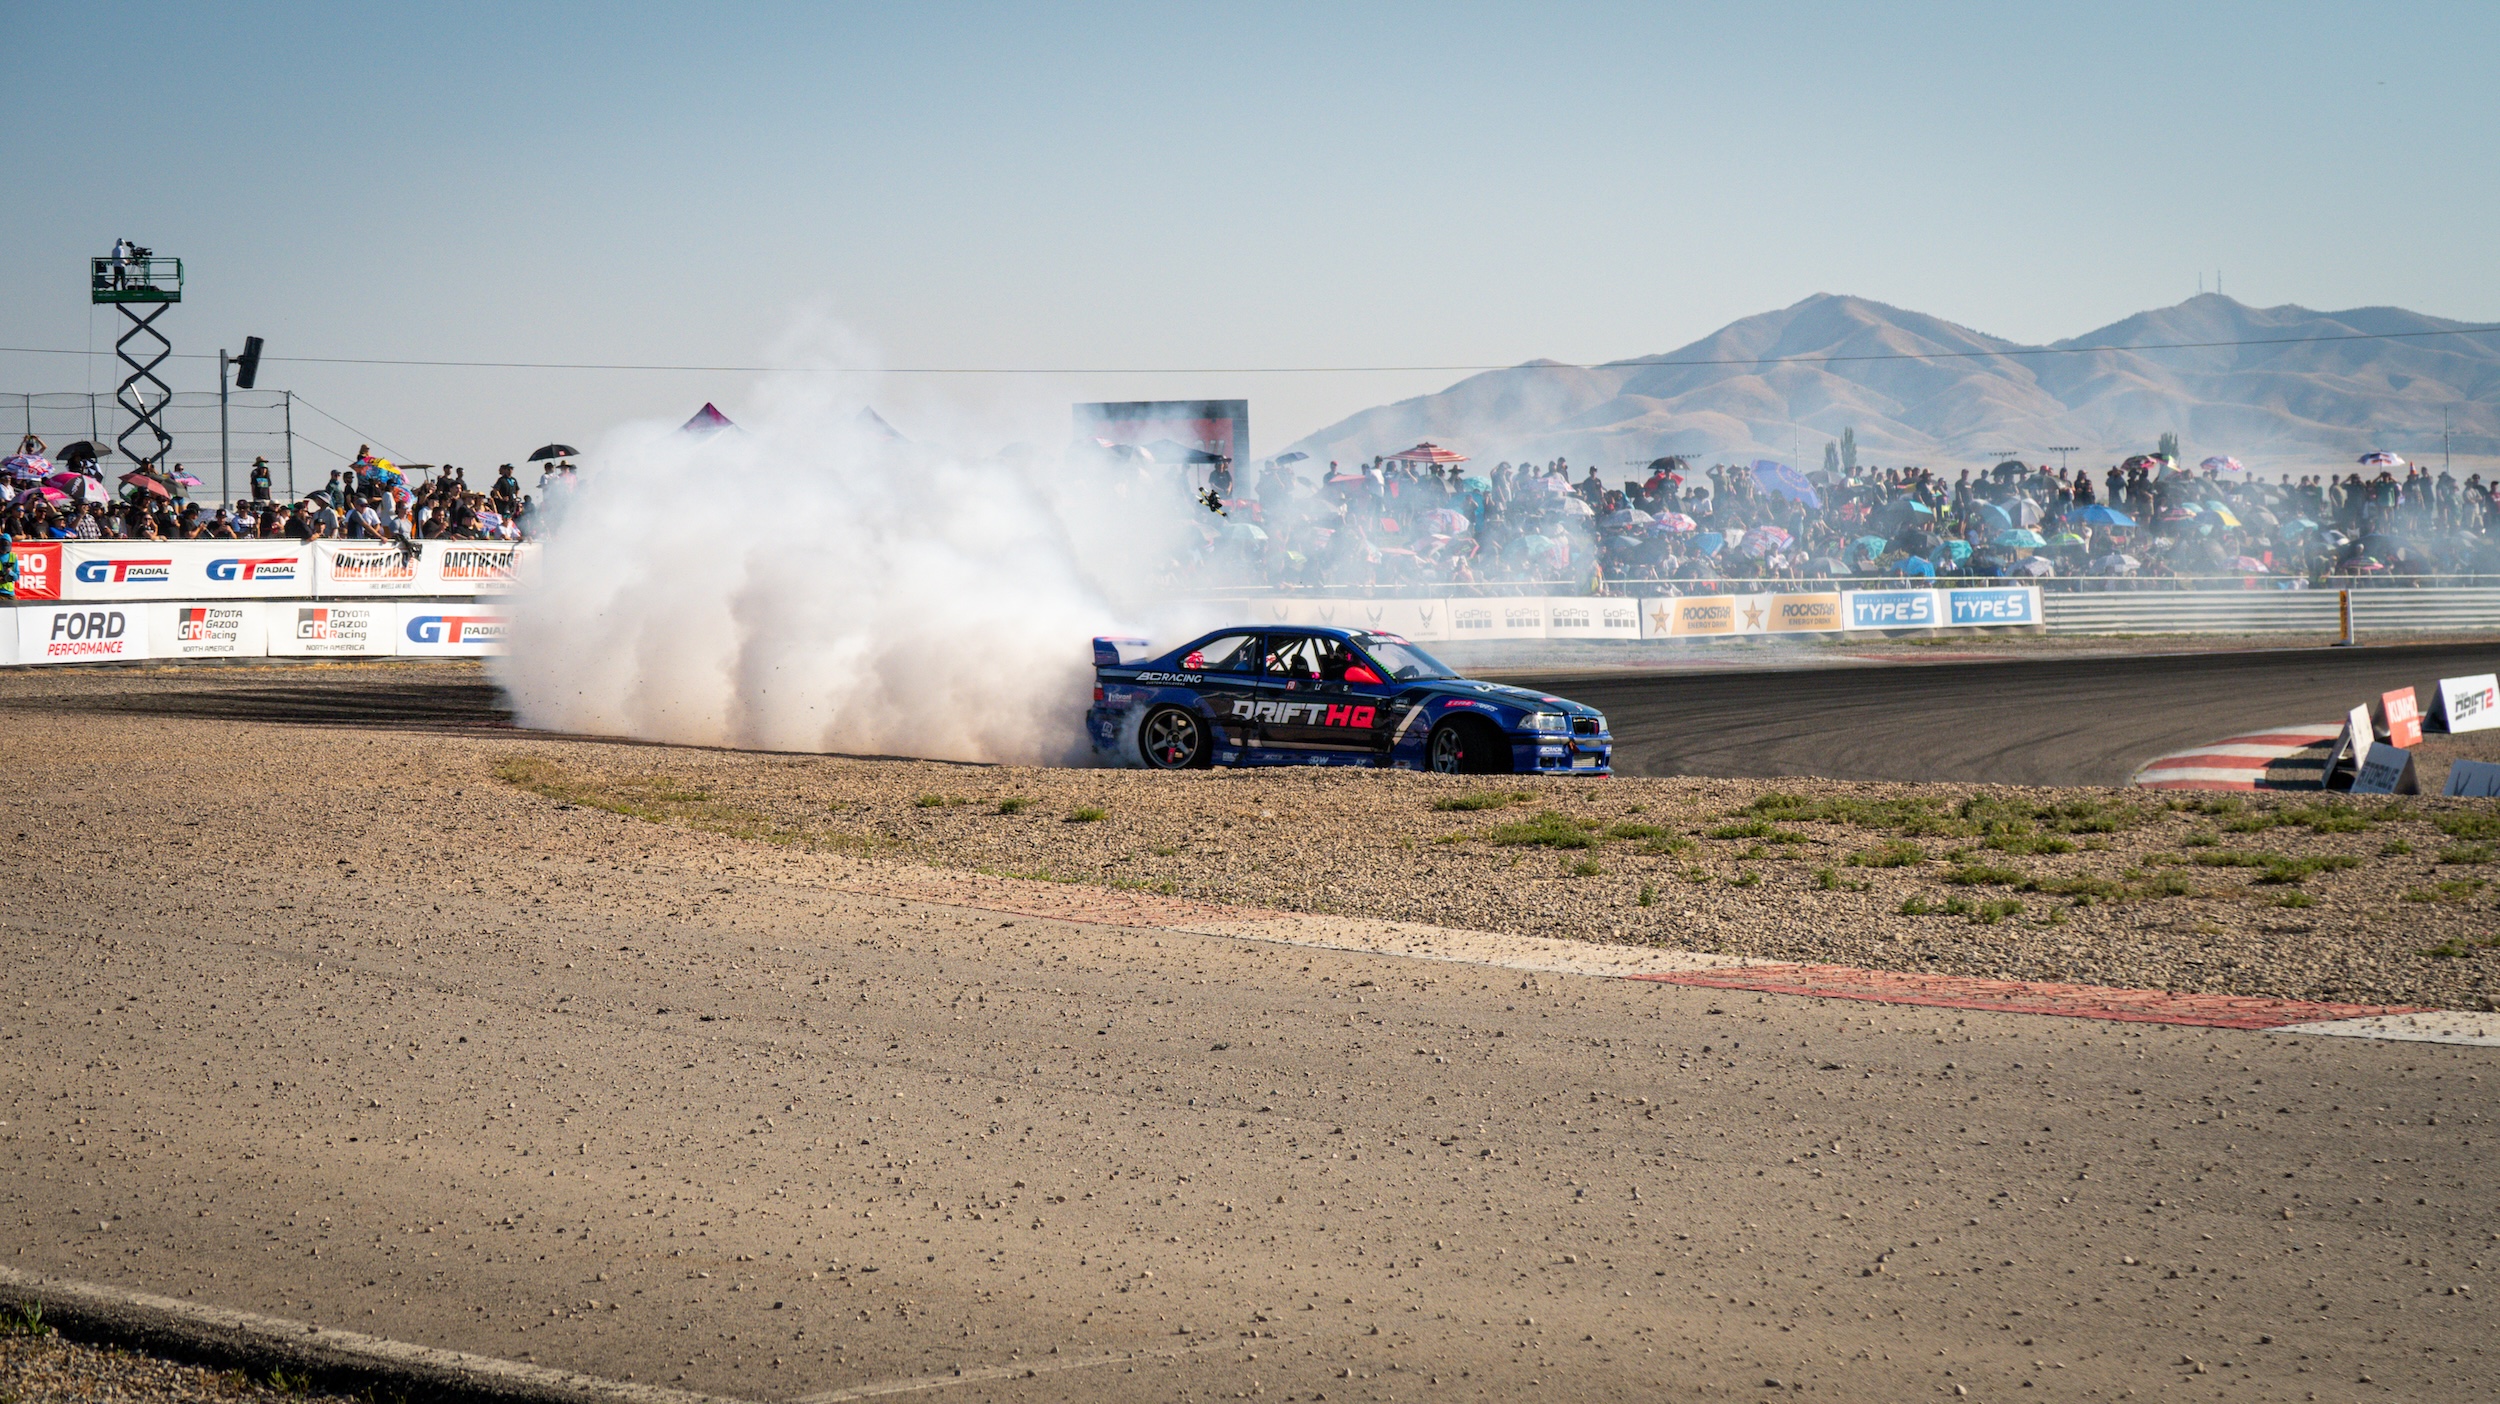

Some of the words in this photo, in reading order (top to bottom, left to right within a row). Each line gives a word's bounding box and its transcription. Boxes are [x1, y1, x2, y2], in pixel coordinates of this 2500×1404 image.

[443, 551, 514, 577] RACETREADS
[128, 568, 169, 576] RADIAL
[209, 609, 243, 618] TOYOTA
[331, 609, 370, 618] TOYOTA
[1454, 609, 1492, 619] GoPro
[1505, 608, 1540, 617] GoPro
[1552, 608, 1589, 617] GoPro
[1603, 608, 1636, 618] GoPro
[51, 611, 125, 640] FORD
[1688, 621, 1711, 629] ENERGY
[329, 630, 367, 641] Racing
[464, 627, 508, 635] RADIAL
[205, 630, 237, 642] Racing
[47, 641, 123, 656] PERFORMANCE
